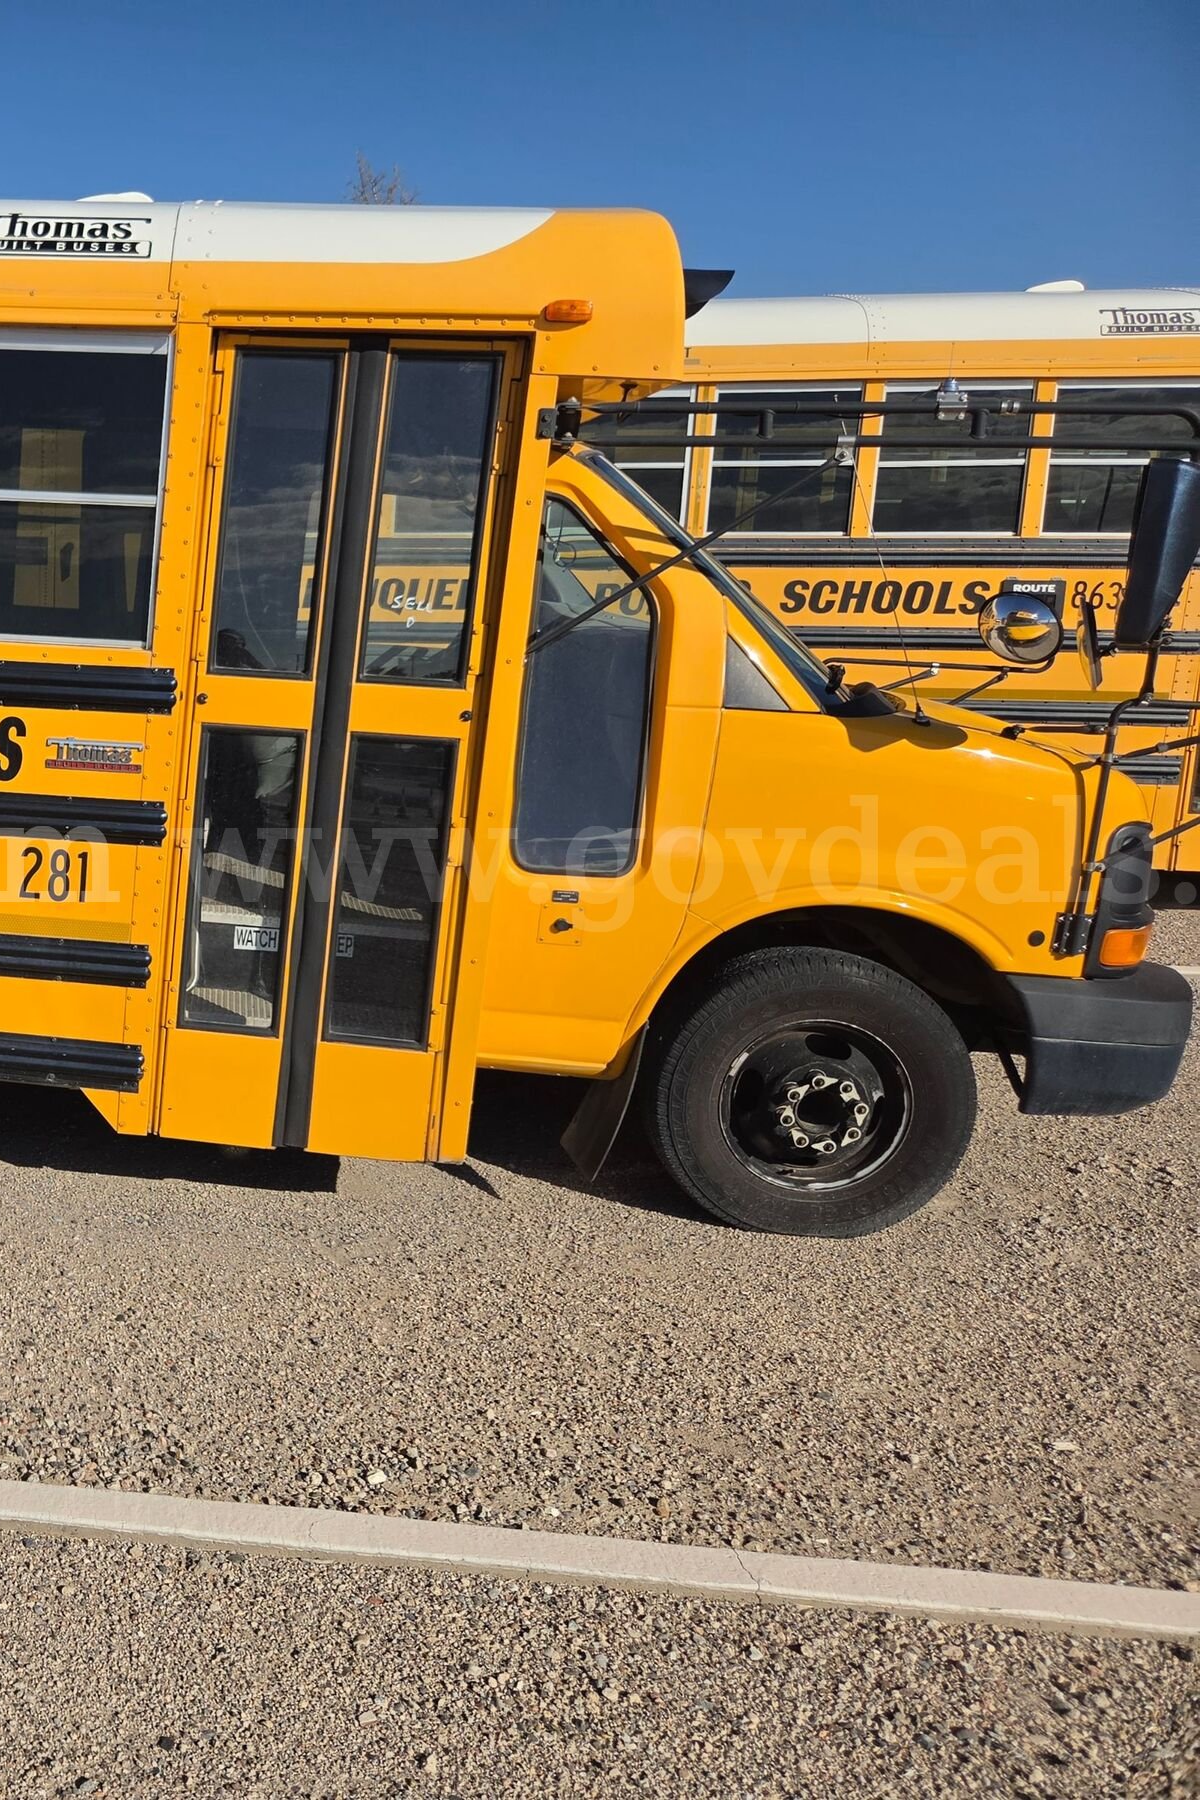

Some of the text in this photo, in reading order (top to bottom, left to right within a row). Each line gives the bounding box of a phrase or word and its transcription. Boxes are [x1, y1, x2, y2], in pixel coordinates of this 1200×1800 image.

[55, 241, 133, 253] BUSES
[1099, 307, 1200, 325] Thomas
[779, 579, 991, 615] SCHOOLS
[1012, 583, 1057, 593] ROUTE
[19, 846, 89, 903] 281
[236, 927, 278, 949] WATCH
